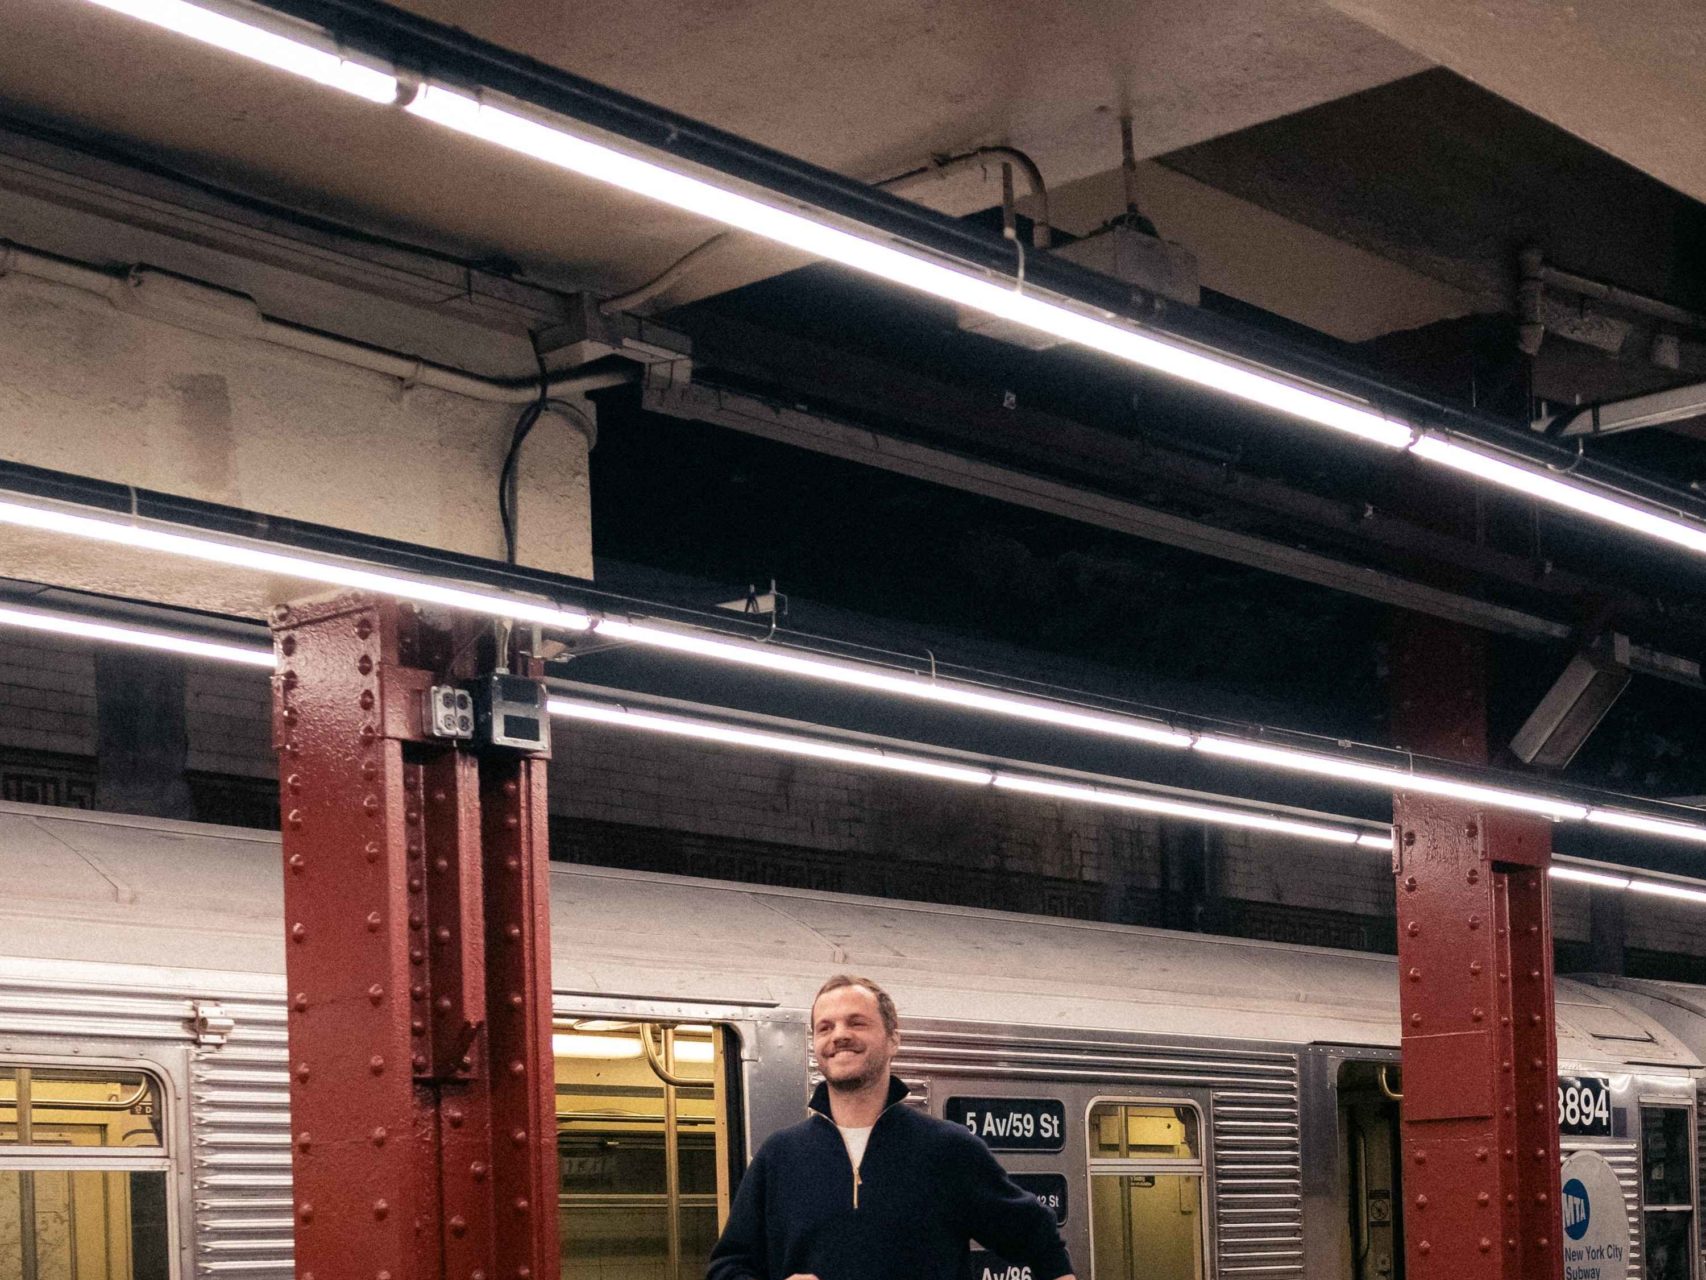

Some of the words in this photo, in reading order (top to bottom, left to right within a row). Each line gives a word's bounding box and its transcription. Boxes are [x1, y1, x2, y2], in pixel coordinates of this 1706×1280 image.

[966, 1112, 977, 1136] 5
[982, 1112, 1035, 1138] Av/59
[1040, 1113, 1060, 1138] St
[1049, 1195, 1059, 1208] St
[1562, 1193, 1586, 1228] MTA
[1565, 1247, 1583, 1262] New
[1585, 1244, 1604, 1260] York
[1606, 1243, 1623, 1262] City
